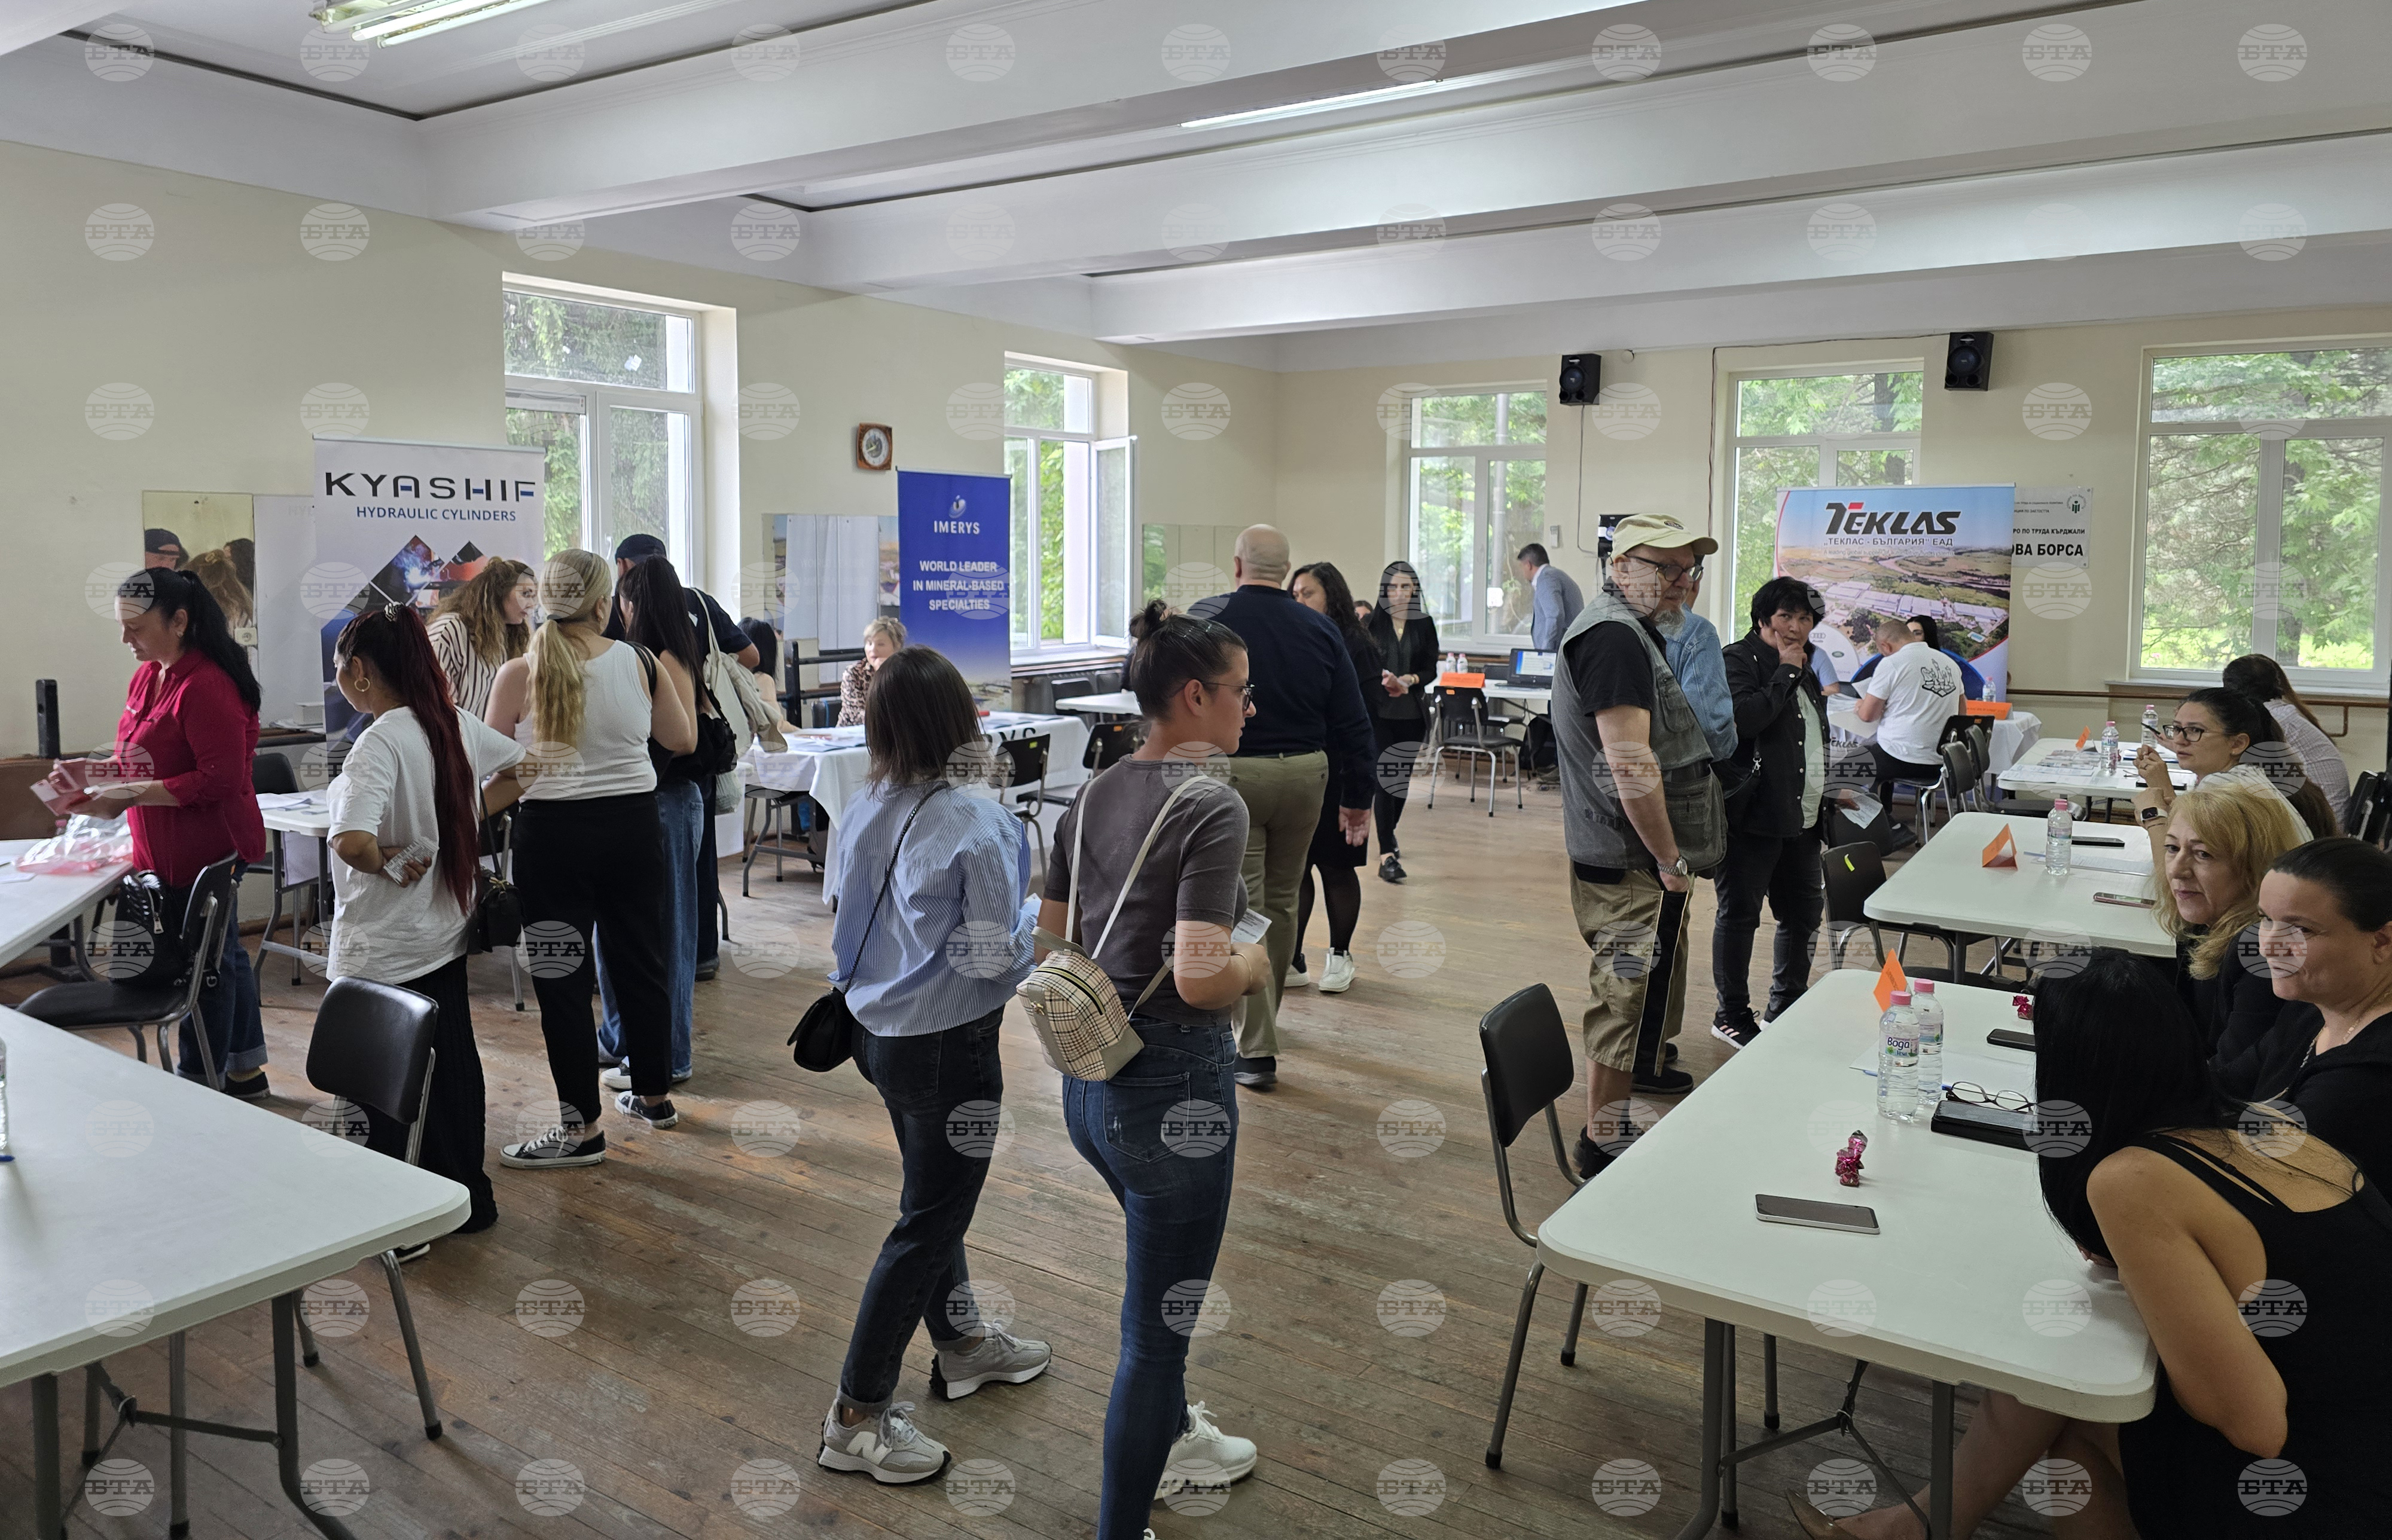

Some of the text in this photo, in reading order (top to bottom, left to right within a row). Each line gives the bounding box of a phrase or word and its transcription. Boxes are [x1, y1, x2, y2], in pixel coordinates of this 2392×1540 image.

[325, 472, 536, 503] KYASHIF
[356, 506, 516, 521] HYDRAULIC CYLINDERS
[1825, 502, 1961, 535] TEKLAS
[933, 520, 980, 534] IMERYS
[2037, 543, 2083, 557] БОРСА
[920, 560, 997, 573] WORLD LEADER
[913, 580, 923, 591] IN
[929, 598, 990, 611] SPECIALTIES
